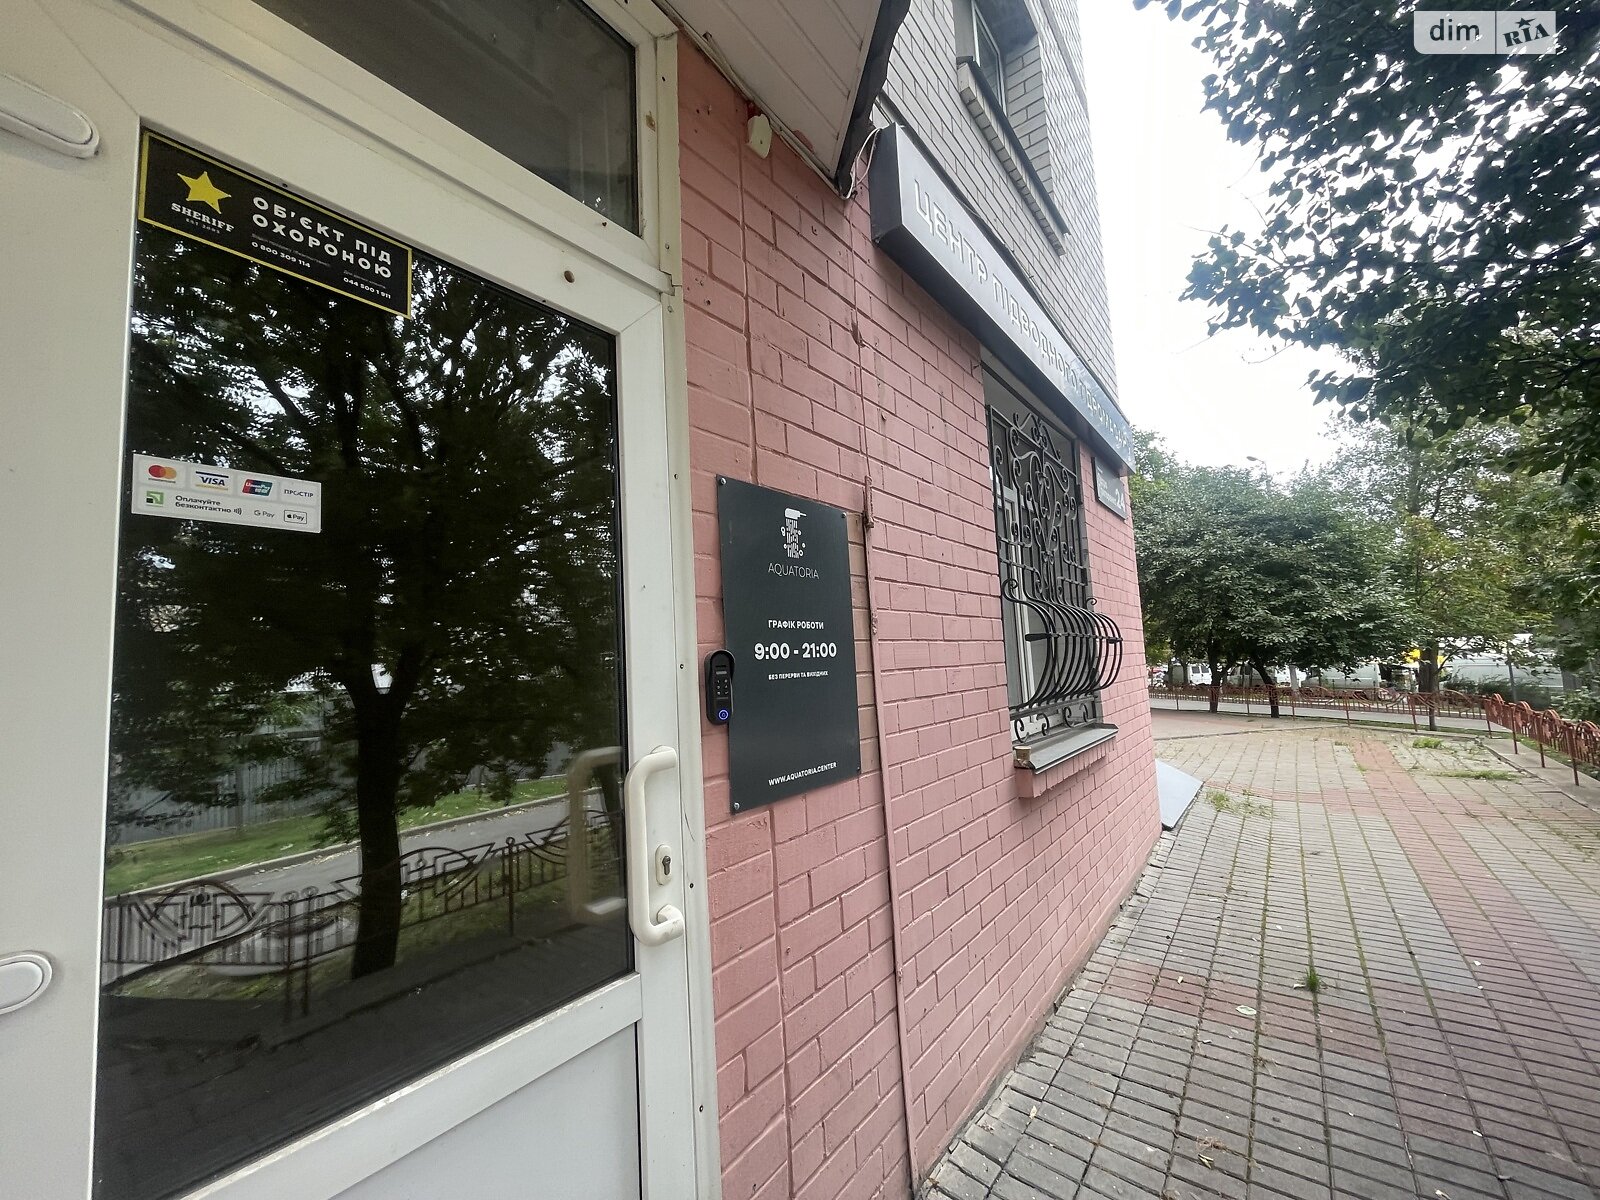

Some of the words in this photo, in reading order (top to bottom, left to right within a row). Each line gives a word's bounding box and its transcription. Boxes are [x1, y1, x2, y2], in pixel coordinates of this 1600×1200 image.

[171, 203, 235, 232] SHERIFF
[253, 197, 344, 242] ОБ'ЄКТ
[355, 240, 391, 265] ПІД
[252, 214, 391, 278] ОХОРОНОЮ
[260, 245, 278, 255] 800
[280, 250, 297, 262] 309
[298, 259, 311, 268] 114
[343, 277, 359, 287] 044
[914, 179, 988, 284] ЦЕНТР
[992, 273, 1078, 390] ПІДВОДНОГО
[200, 476, 225, 486] VISA
[175, 495, 221, 506] Оплачуйте
[175, 501, 232, 513] безконтактно
[1115, 488, 1126, 513] 24
[768, 563, 820, 579] AQUATORIA
[768, 619, 796, 629] ГРАФІК
[797, 621, 824, 629] РОБОТИ
[754, 643, 790, 660] 9:00
[802, 642, 837, 658] 21:00
[768, 762, 837, 786] WWW.AQUATORIA.CENTER
